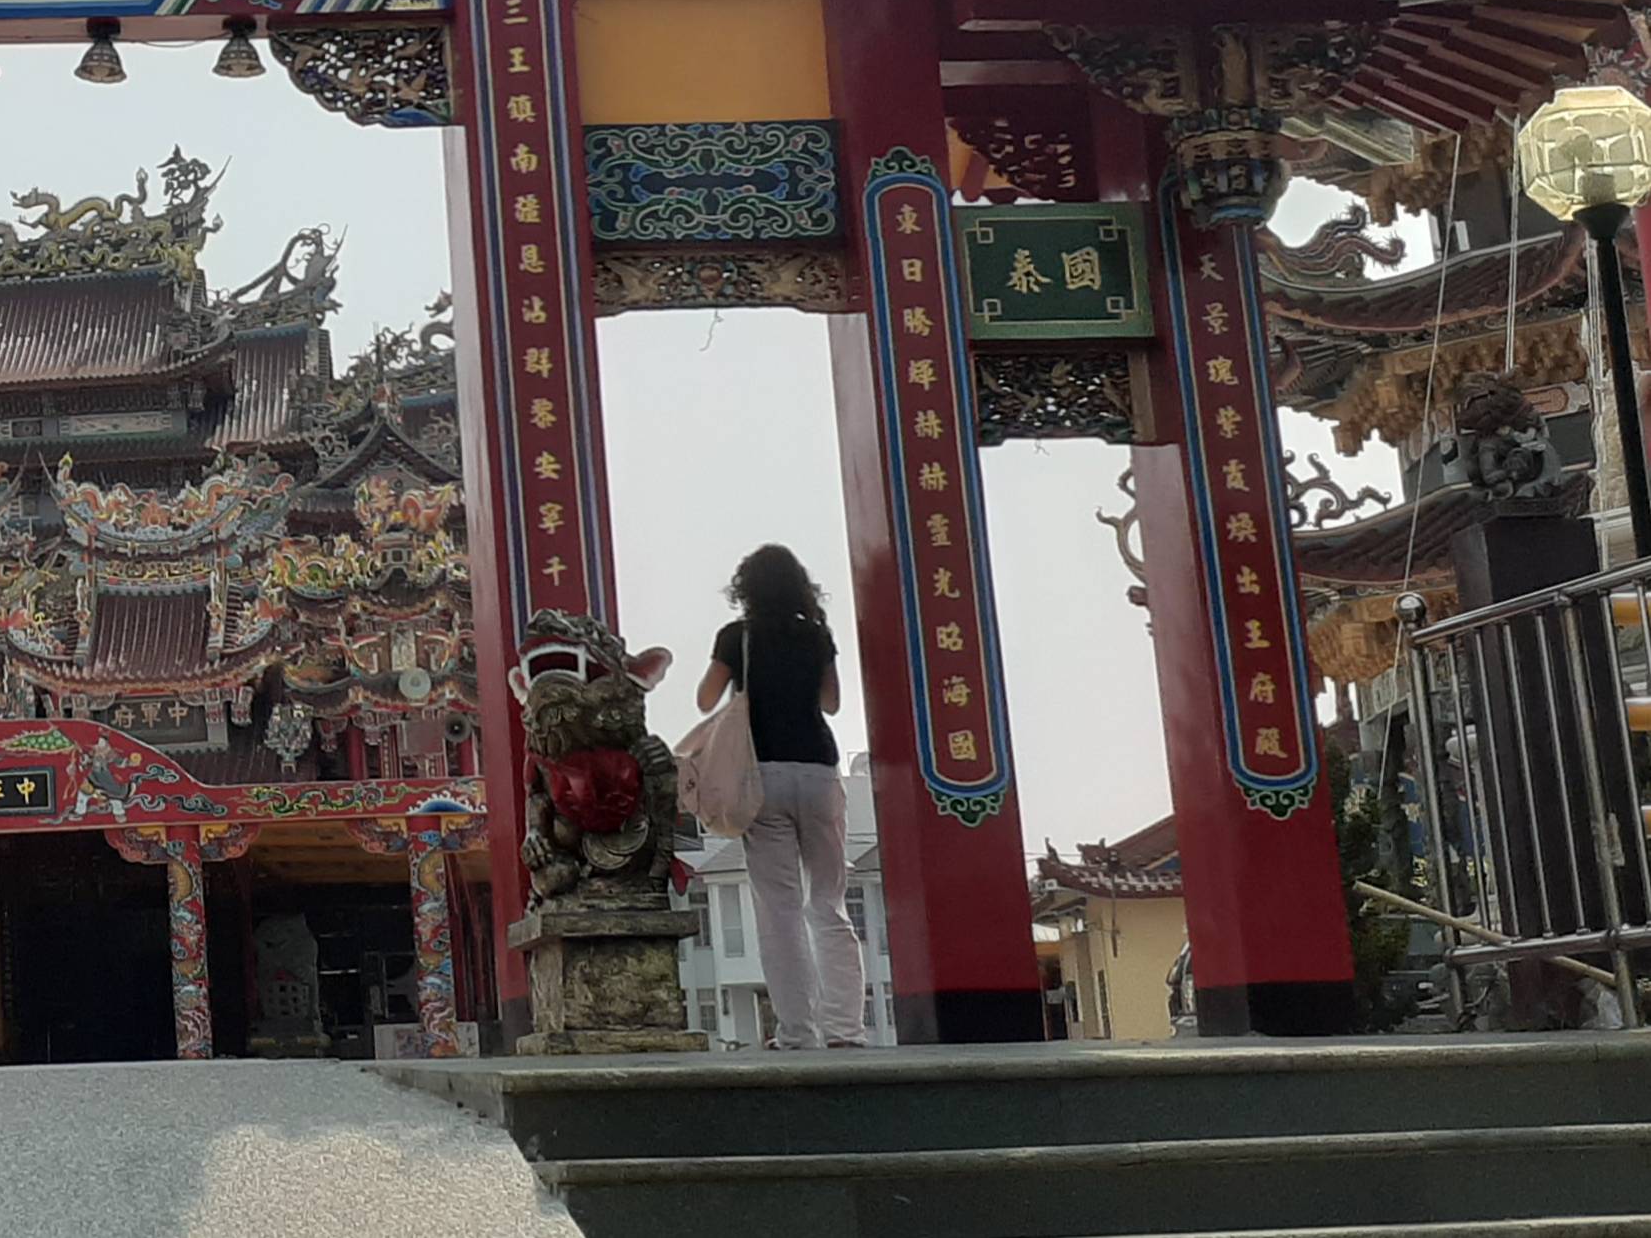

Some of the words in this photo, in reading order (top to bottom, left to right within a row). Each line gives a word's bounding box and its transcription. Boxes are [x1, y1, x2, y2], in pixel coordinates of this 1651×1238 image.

[1005, 245, 1102, 296] 國泰
[111, 700, 189, 729] 中軍府
